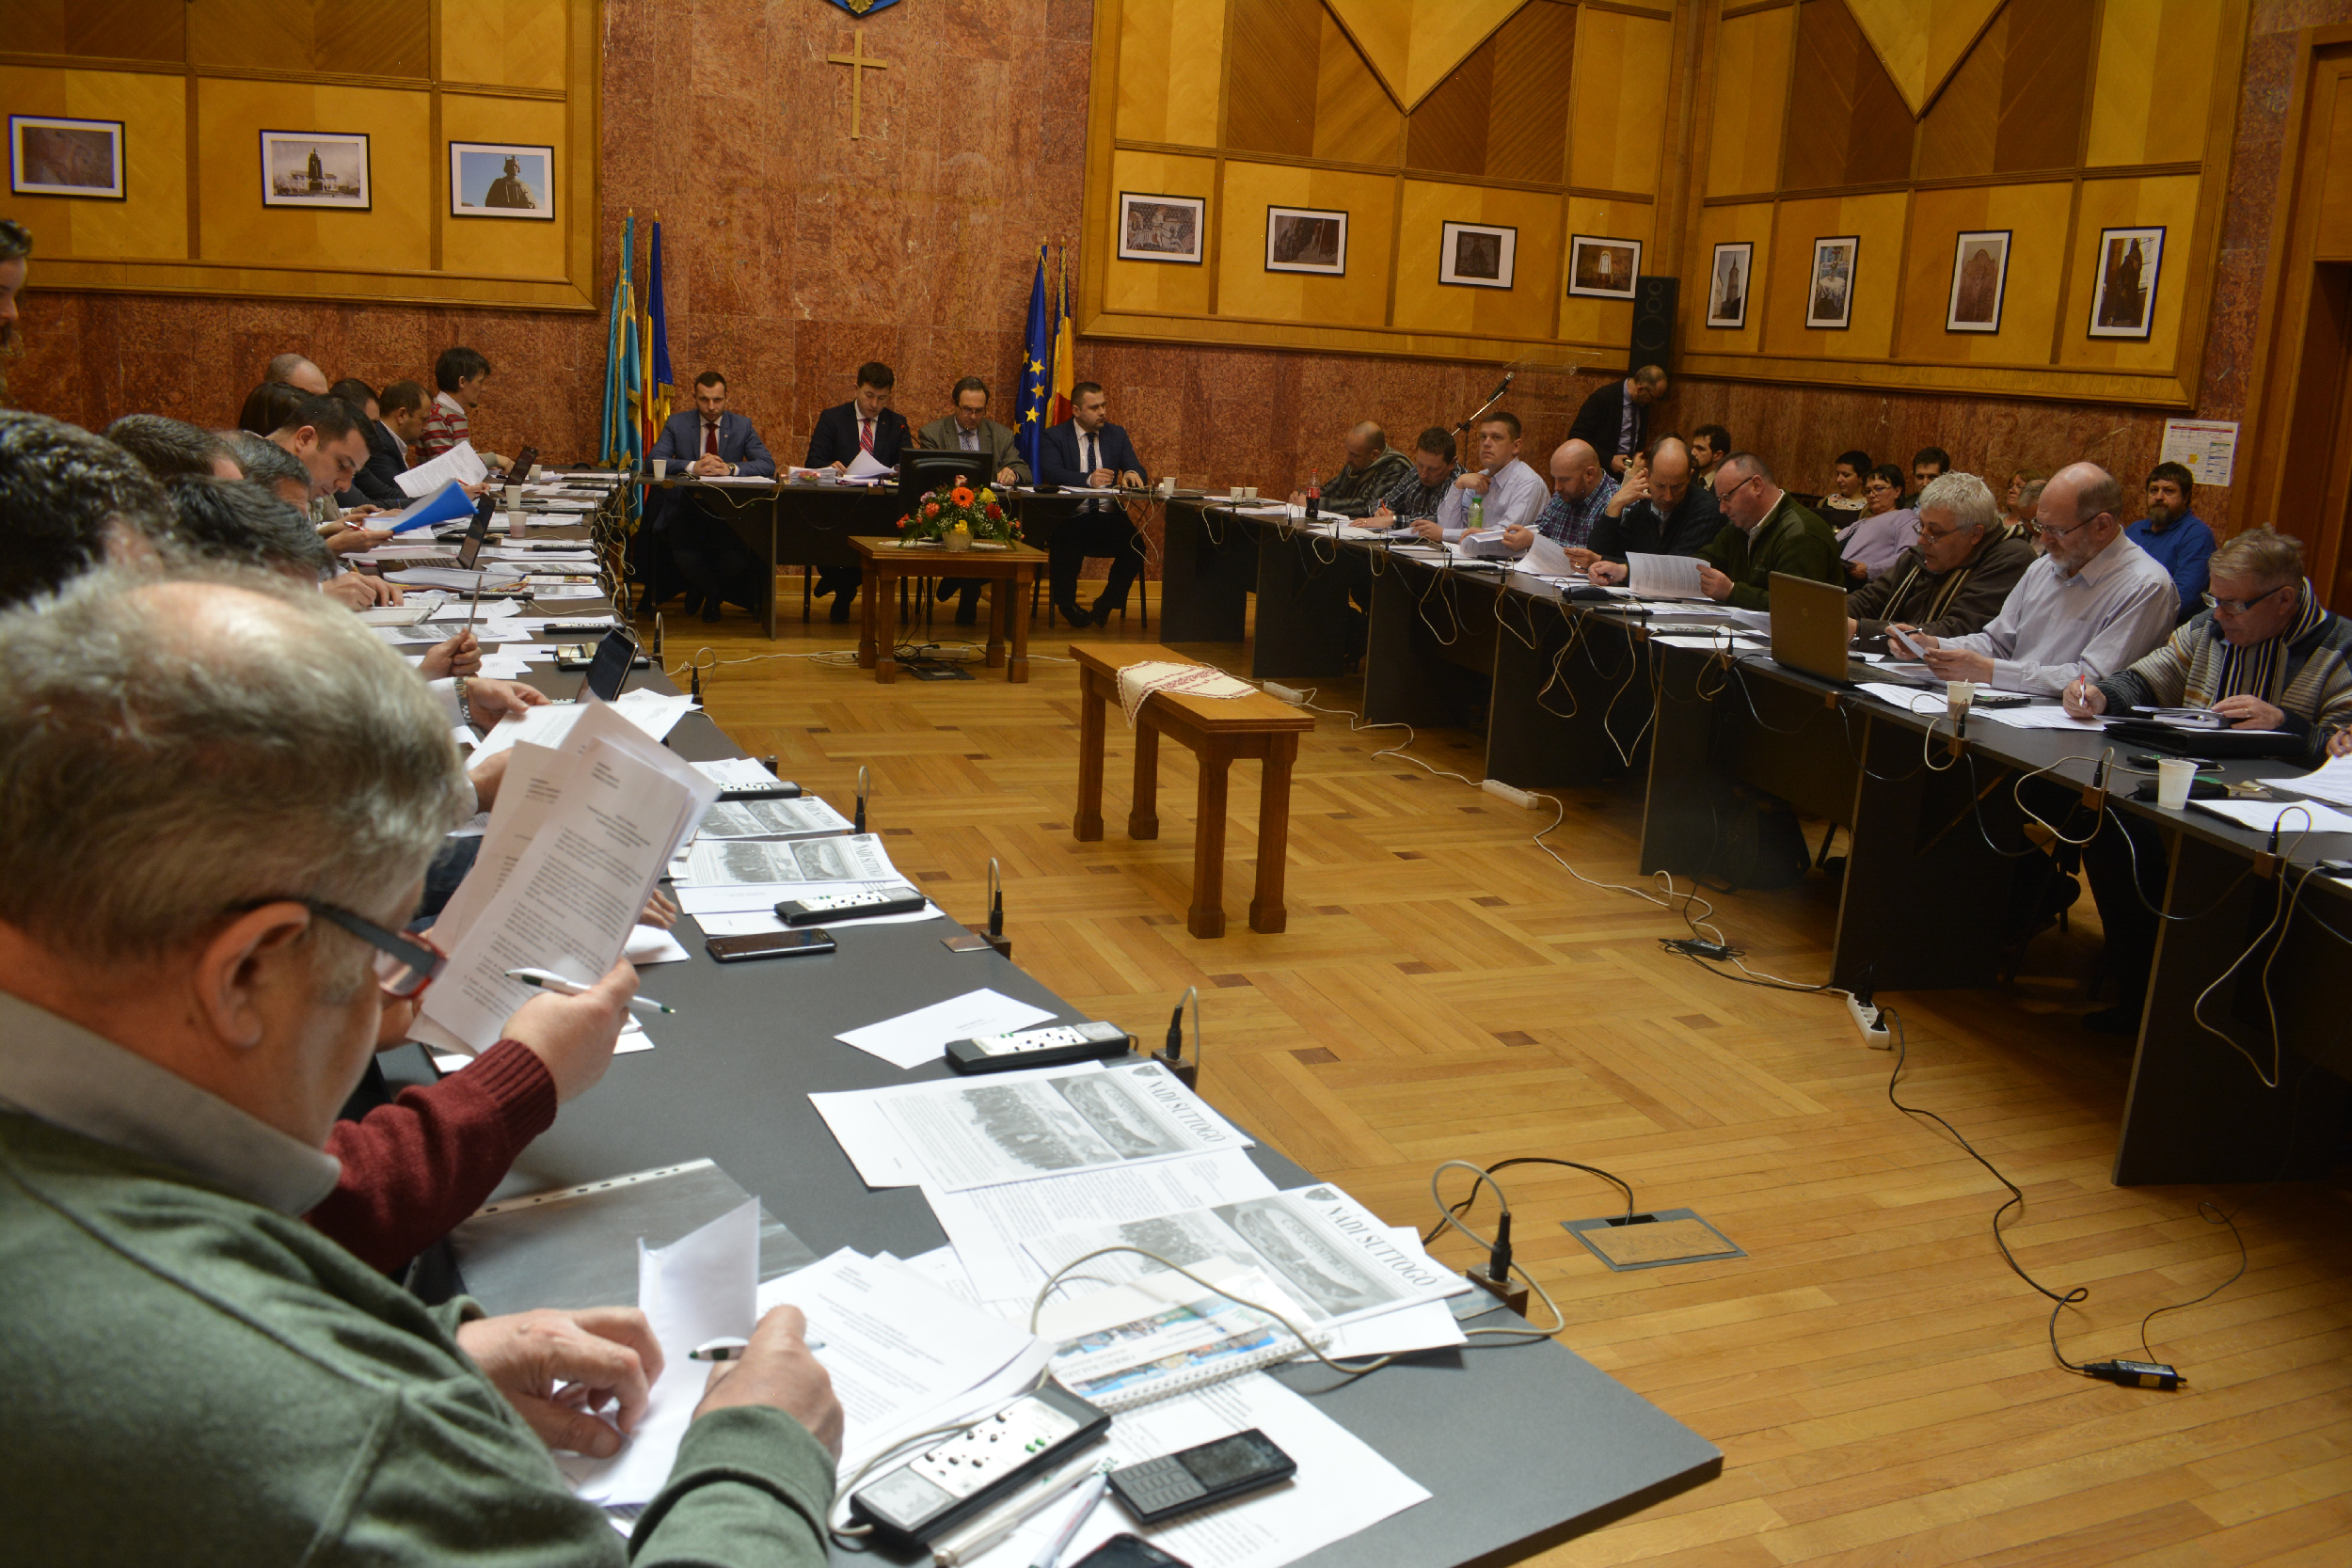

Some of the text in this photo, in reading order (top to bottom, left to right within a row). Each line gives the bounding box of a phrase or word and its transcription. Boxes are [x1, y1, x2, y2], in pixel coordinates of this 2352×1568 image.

[1142, 1081, 1232, 1142] NÁDI SUTTOGÓ
[1322, 1206, 1444, 1286] NÁDI SUTTOGÓ
